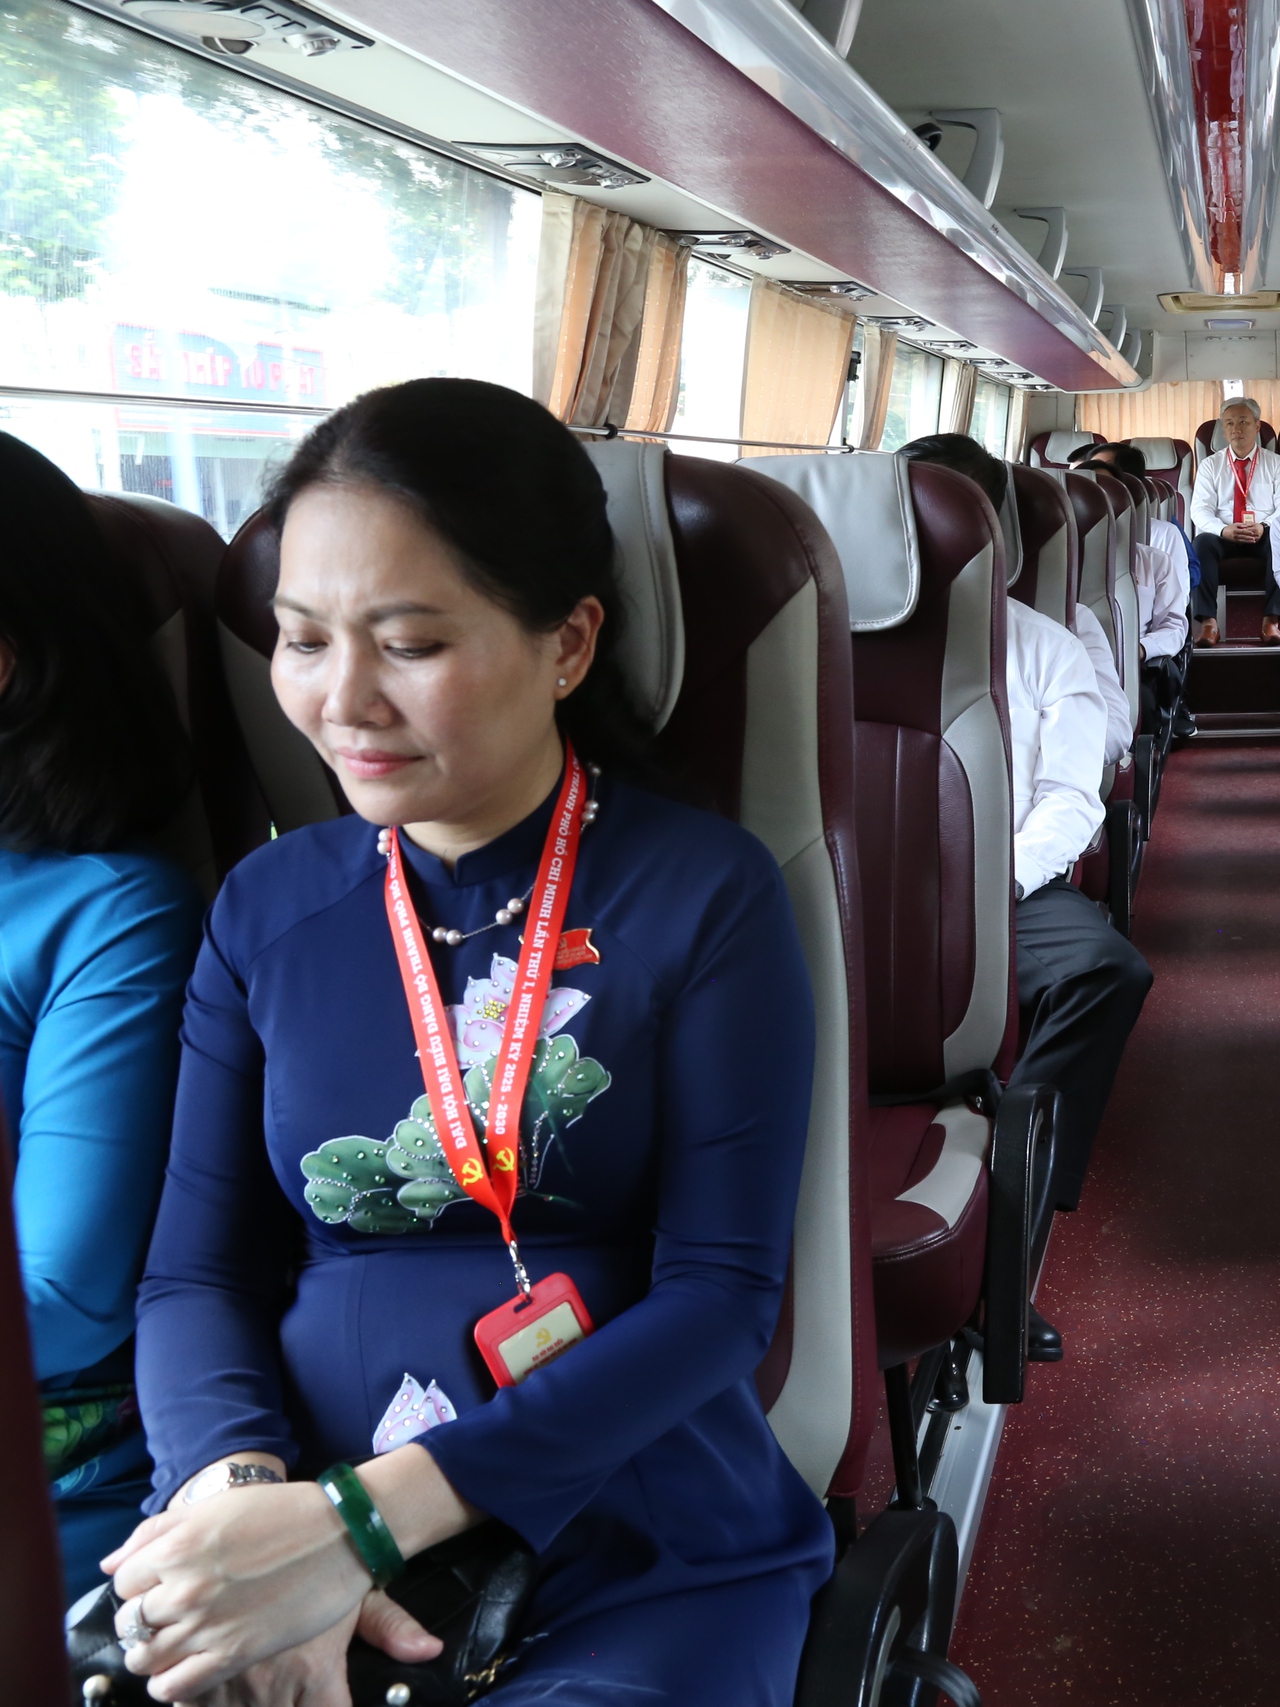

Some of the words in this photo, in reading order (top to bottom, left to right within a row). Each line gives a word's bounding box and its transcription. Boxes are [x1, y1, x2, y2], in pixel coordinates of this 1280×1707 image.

[565, 771, 580, 811] THÀNH
[548, 857, 562, 882] CHÍ
[539, 883, 557, 919] MINH
[402, 927, 423, 974] THÀNH
[526, 951, 542, 980] THỨ
[413, 974, 428, 994] BỘ
[420, 994, 439, 1035] ĐẢNG
[512, 993, 533, 1040] NHIỆM
[426, 1035, 447, 1067] BIỂU
[508, 1042, 522, 1062] KỲ
[437, 1067, 453, 1094] ĐẠI
[500, 1063, 517, 1093] 2025
[442, 1094, 459, 1121] HỘI
[494, 1103, 508, 1135] 2030
[449, 1121, 468, 1149] ĐẠI
